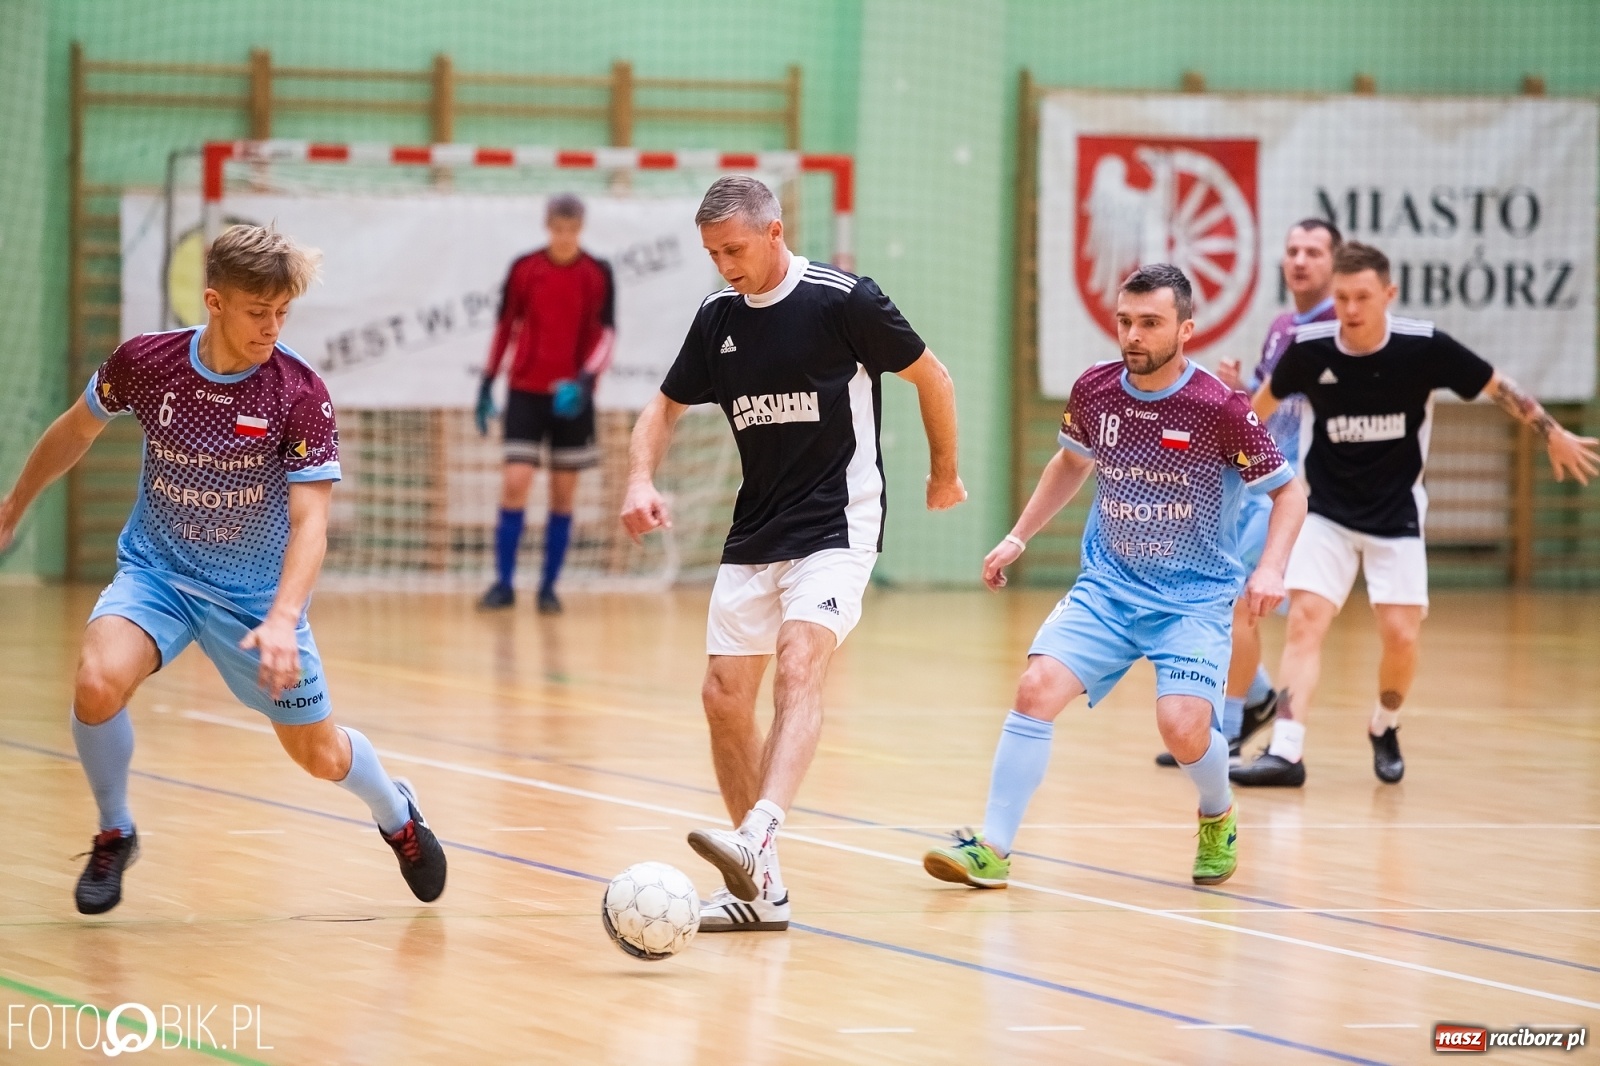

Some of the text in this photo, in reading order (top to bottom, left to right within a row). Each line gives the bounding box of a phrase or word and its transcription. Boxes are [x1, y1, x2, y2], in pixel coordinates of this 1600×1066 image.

[1314, 184, 1541, 238] MIASTO
[158, 391, 177, 427] 6
[748, 415, 773, 424] PRD
[751, 392, 820, 424] KUHN
[1099, 412, 1121, 448] 18
[152, 476, 264, 509] AGROTIM
[1101, 496, 1193, 522] AGROTIM
[1112, 538, 1175, 558] KIETRZ
[1170, 670, 1217, 689] Int-Drew
[274, 691, 324, 709] Int-Drew
